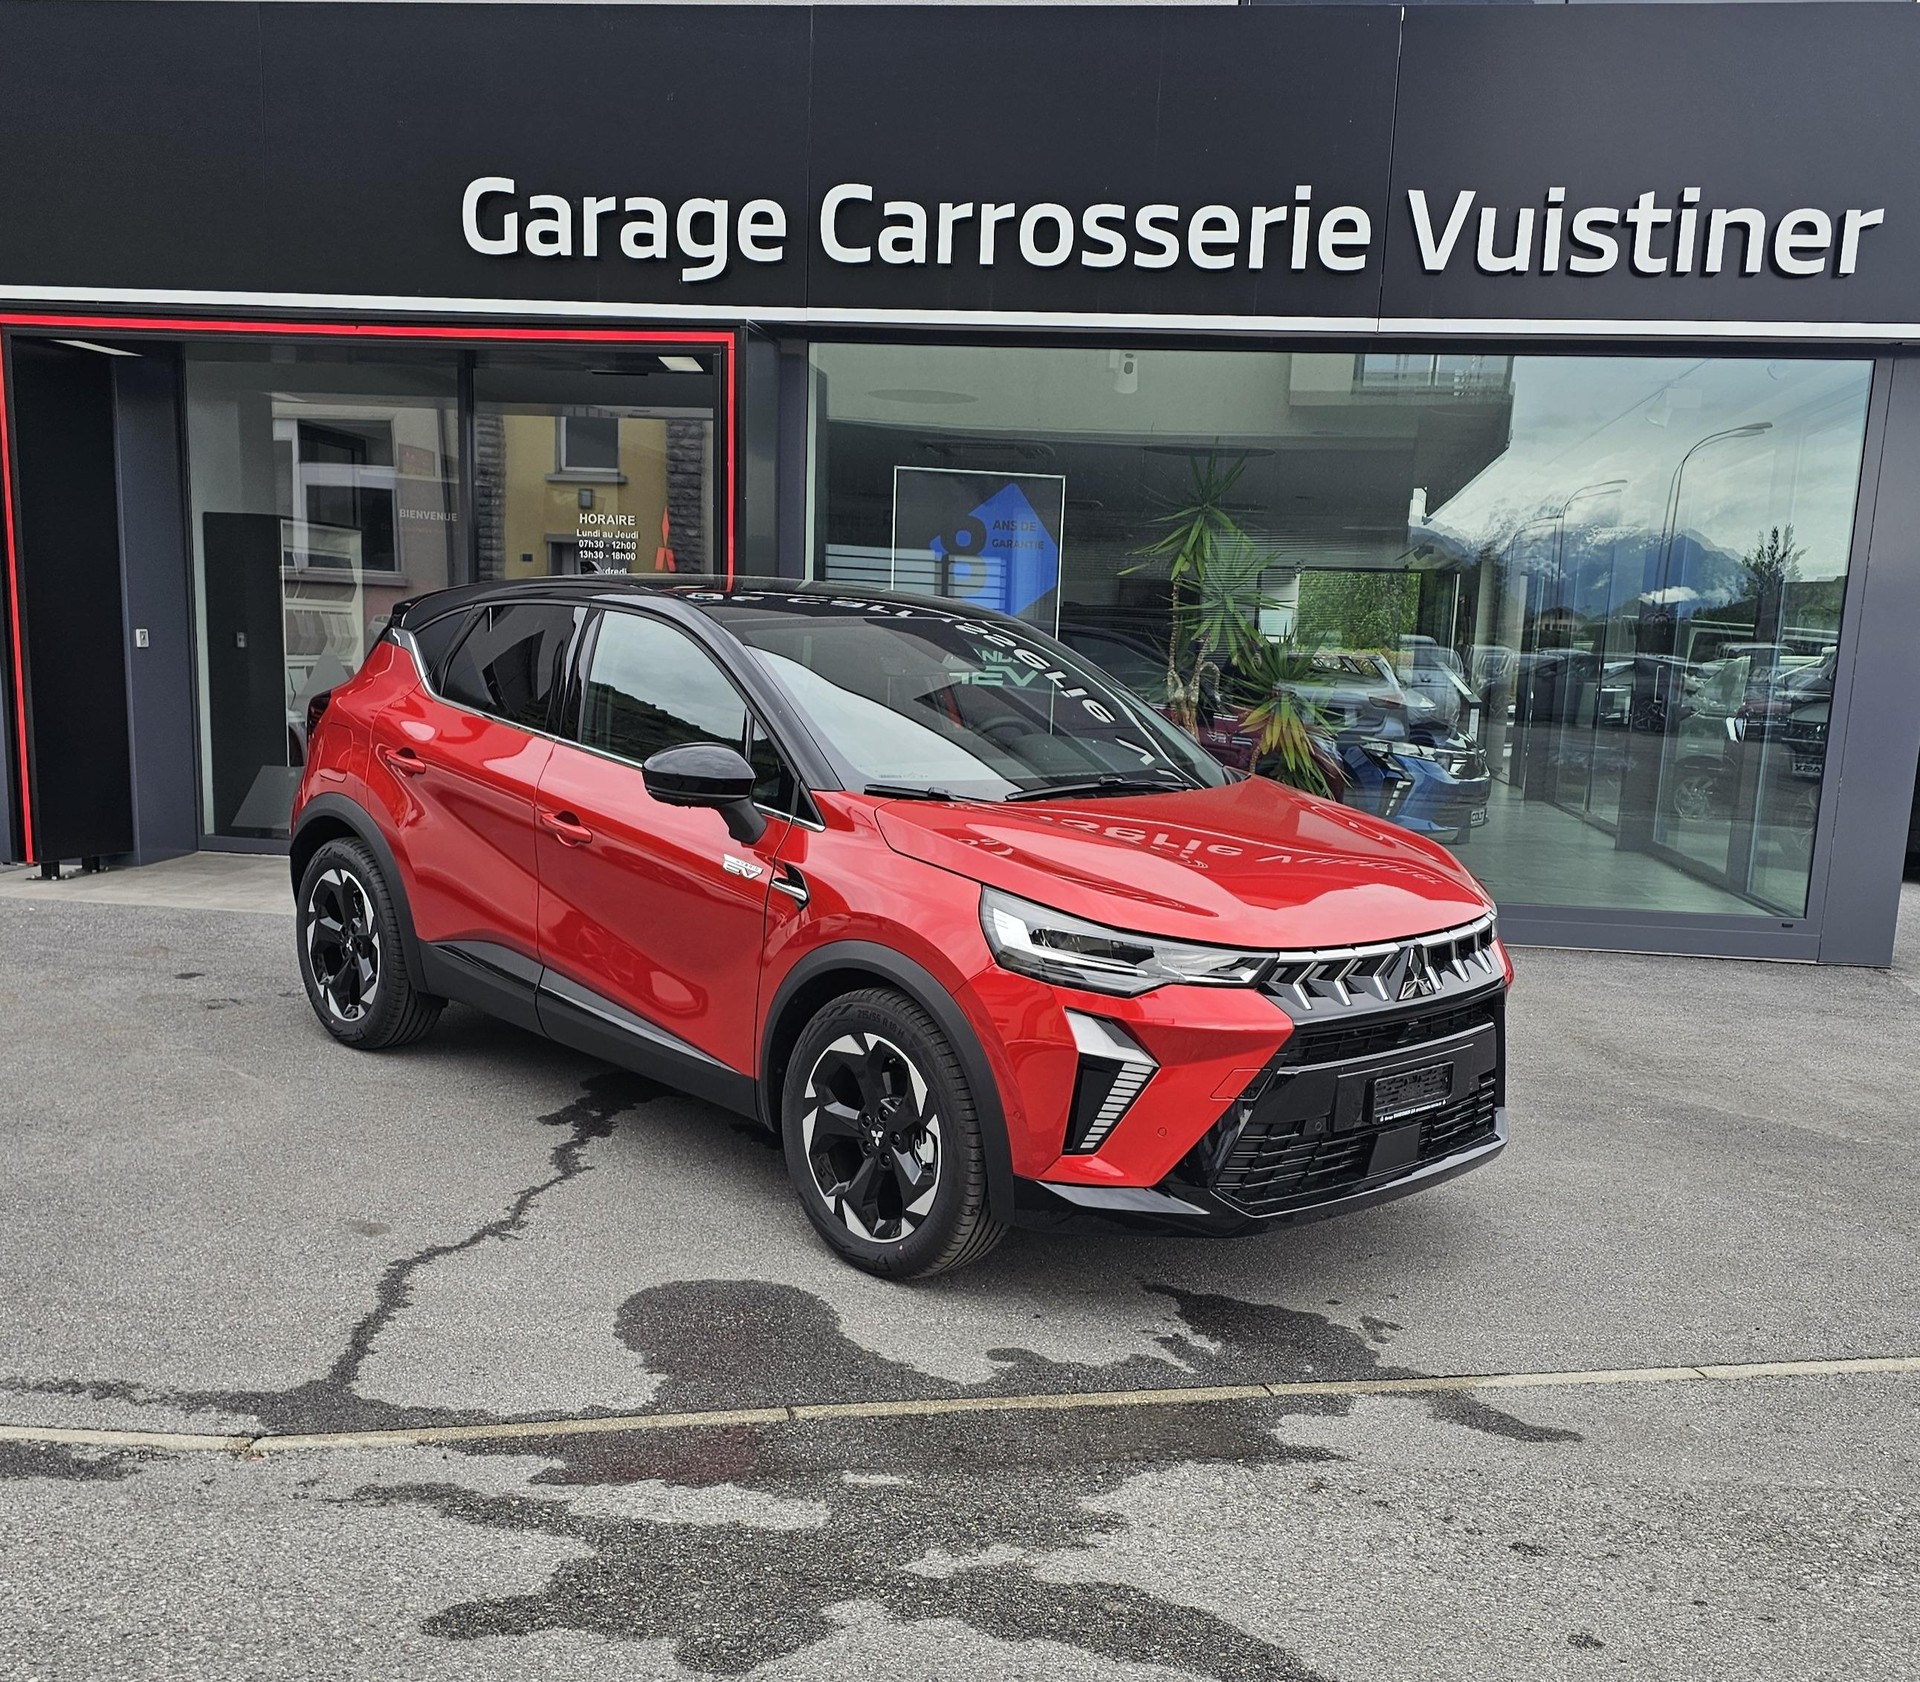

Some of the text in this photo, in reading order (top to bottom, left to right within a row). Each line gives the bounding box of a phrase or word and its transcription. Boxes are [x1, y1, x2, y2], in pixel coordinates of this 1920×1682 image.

[462, 176, 1885, 283] Garage Carrosserie Vuistiner
[399, 508, 459, 522] BIENVENUE
[579, 513, 636, 526] HORAIRE
[992, 519, 1037, 532] ANS DE
[576, 528, 639, 540] Lundi au Jeudi
[578, 539, 604, 549] 07h30
[611, 540, 637, 550] 12h00
[992, 538, 1045, 550] GARANTIE
[578, 550, 604, 559] 13h30
[611, 551, 637, 561] 18h00
[1471, 811, 1484, 822] COLT
[856, 1009, 881, 1023] 215/55
[883, 1017, 889, 1027] R
